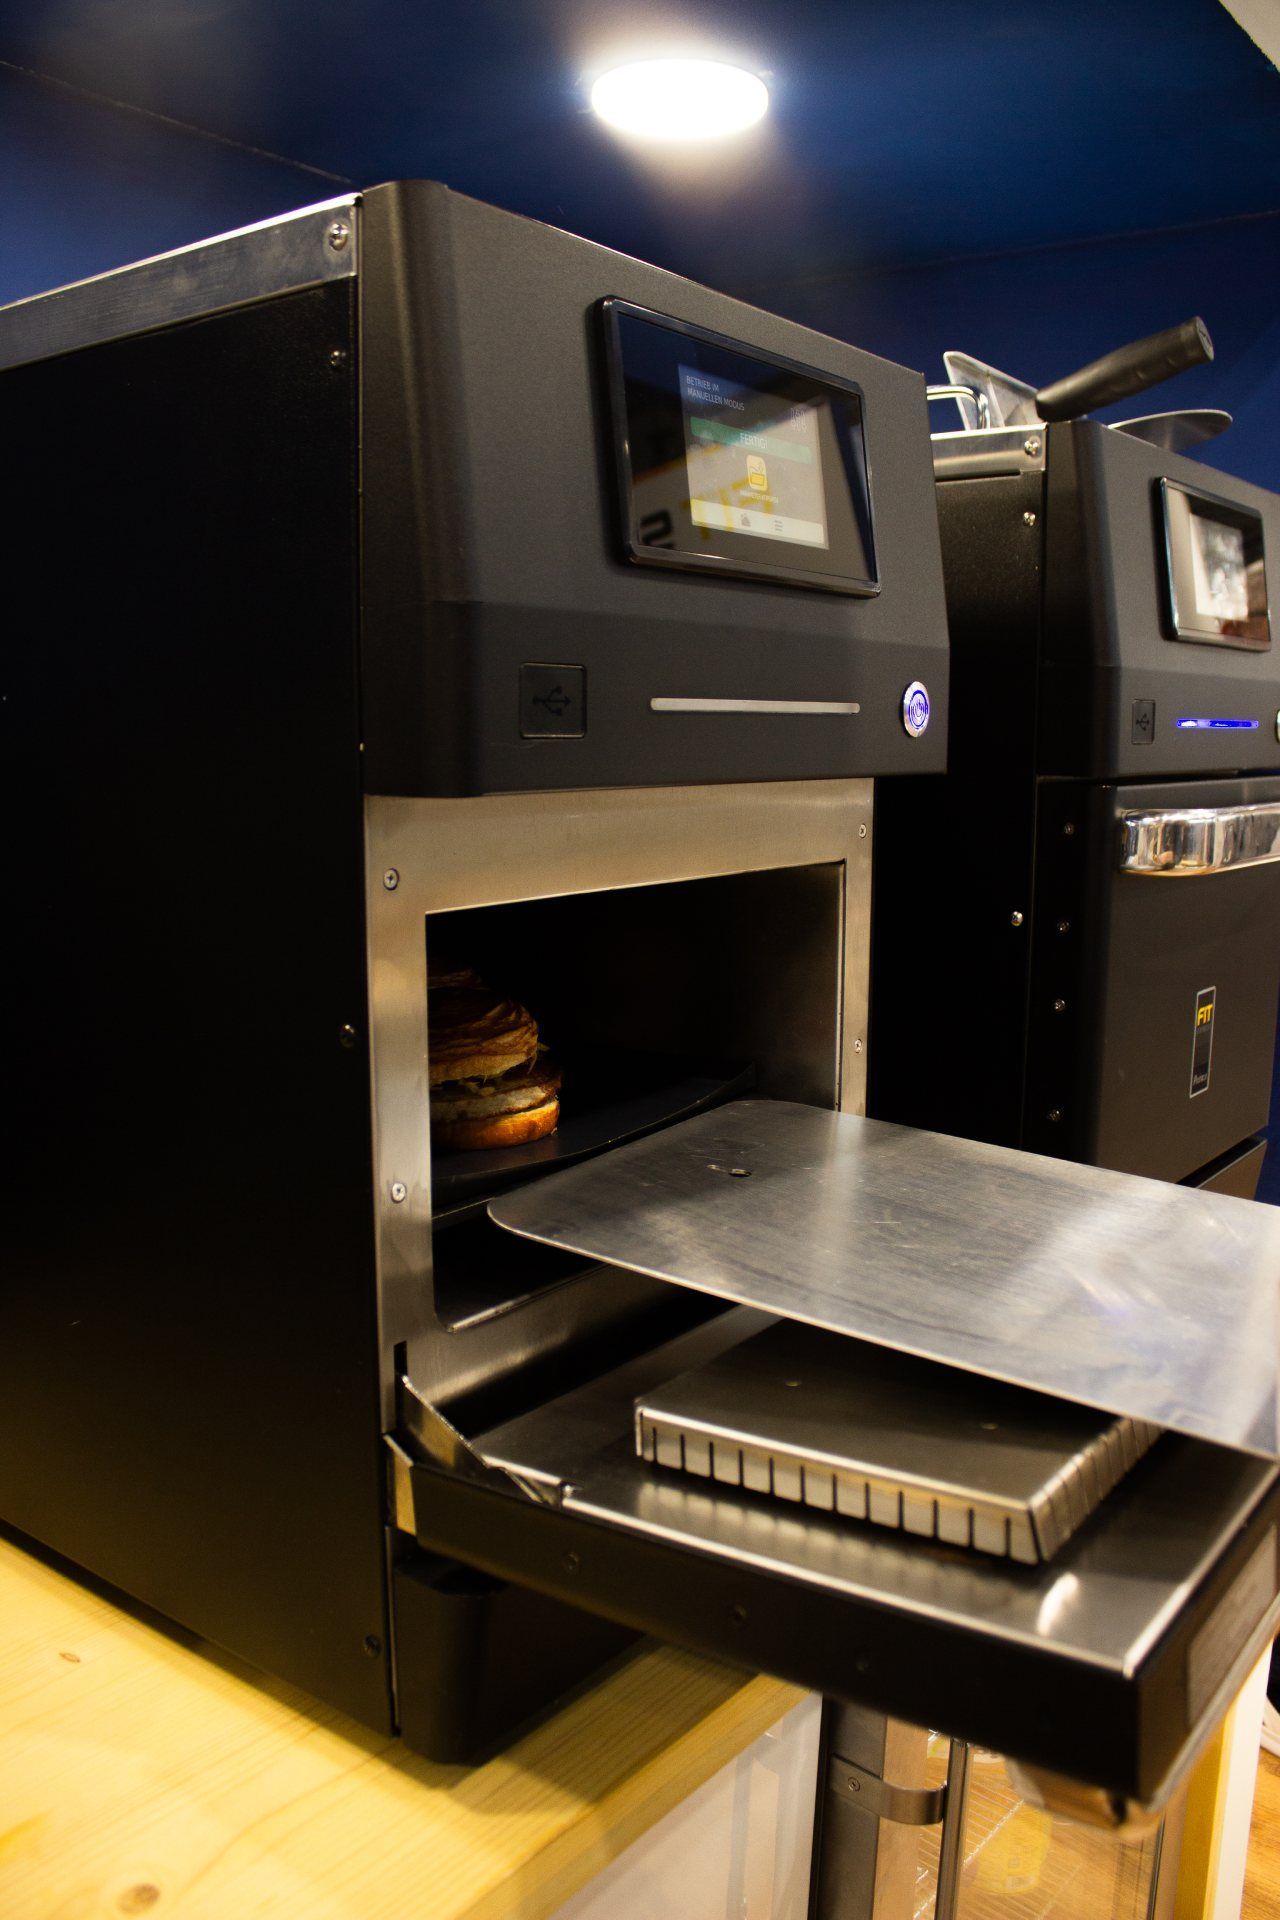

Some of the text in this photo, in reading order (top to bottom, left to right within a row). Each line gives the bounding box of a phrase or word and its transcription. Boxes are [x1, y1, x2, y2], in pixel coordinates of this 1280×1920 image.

[686, 375, 711, 391] BETRIEB
[687, 387, 745, 411] MANUELLEN MODUS
[1197, 1004, 1214, 1026] FIT
